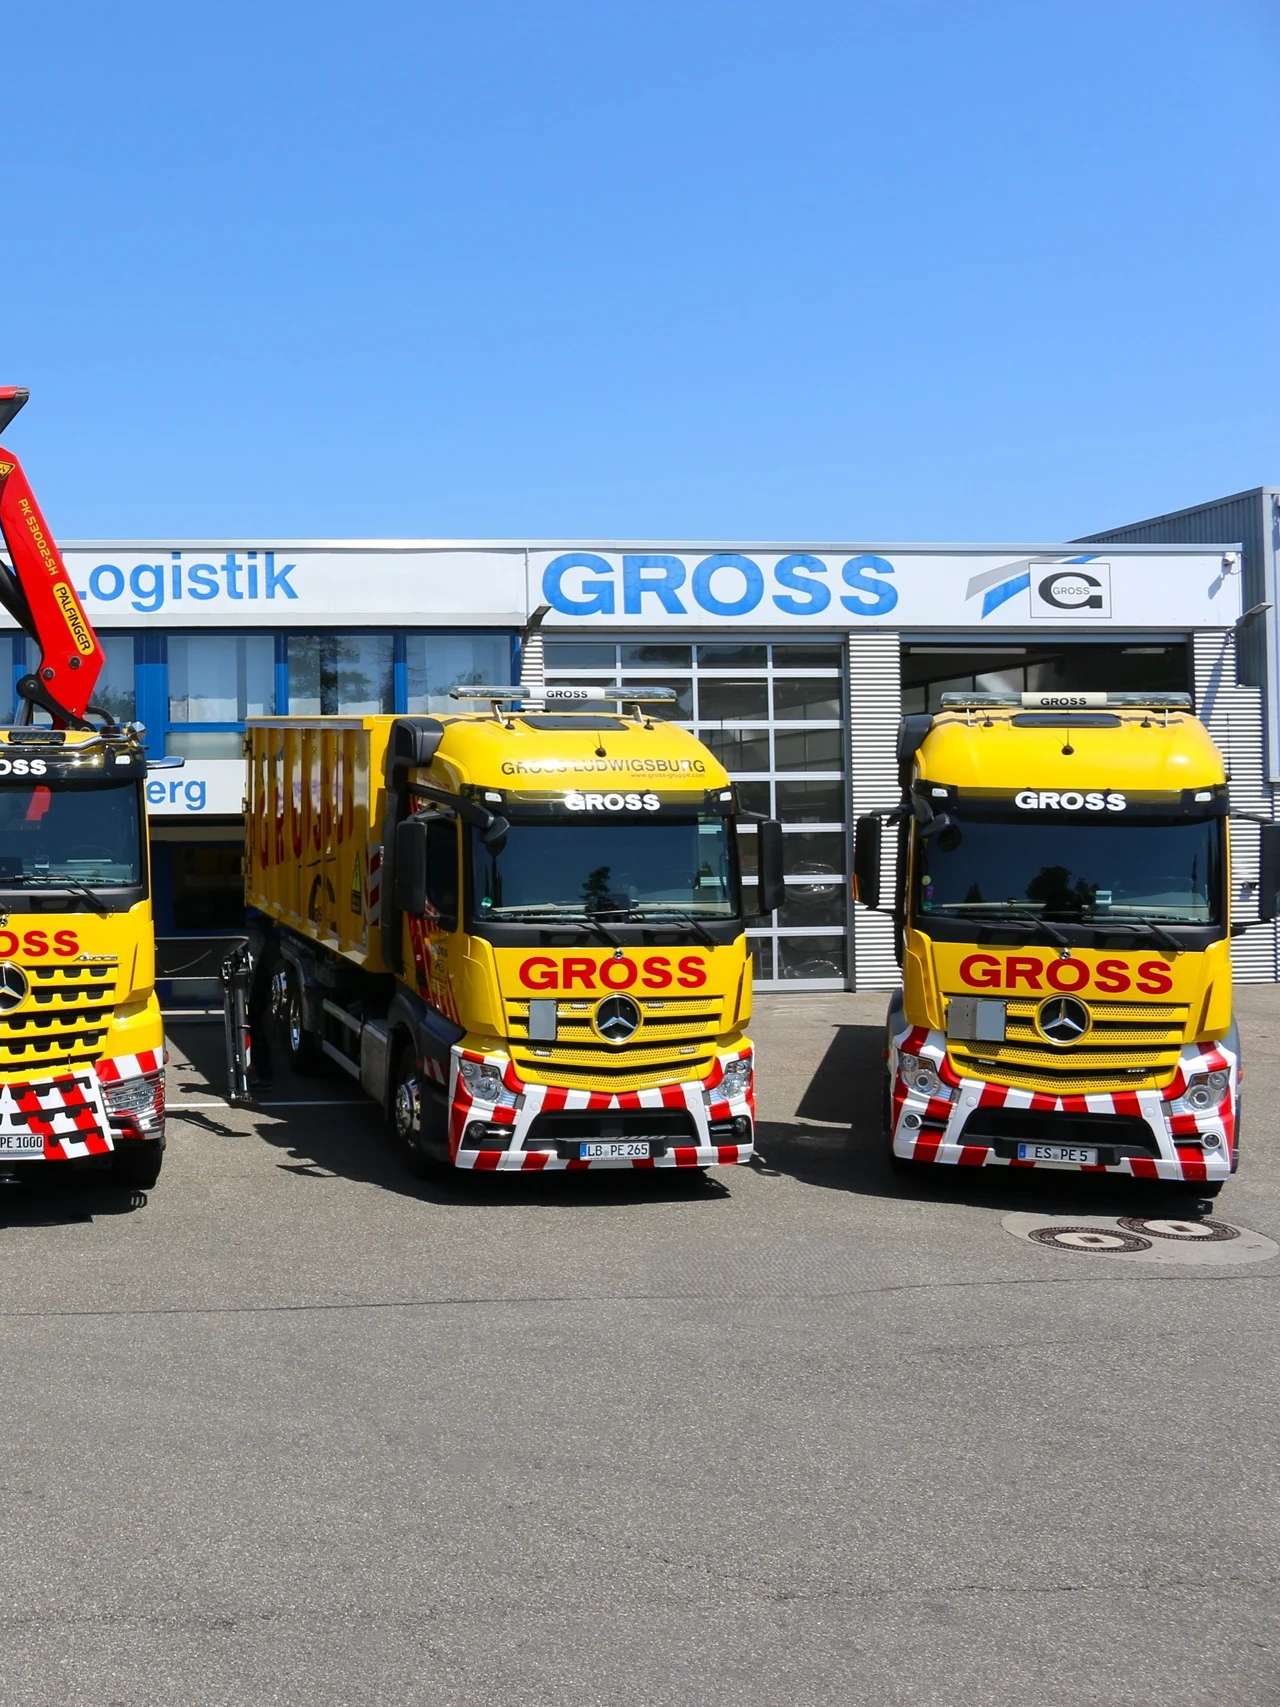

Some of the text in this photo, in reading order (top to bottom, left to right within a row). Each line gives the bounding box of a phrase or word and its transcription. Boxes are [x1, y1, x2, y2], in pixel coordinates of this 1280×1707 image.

[18, 498, 33, 516] PK
[75, 552, 299, 613] ogistik
[542, 553, 899, 616] GROSS
[1052, 586, 1090, 595] GROSS
[56, 586, 91, 651] PALFINGER
[546, 690, 588, 698] GROSS
[1040, 697, 1087, 706] GROSS
[572, 758, 706, 773] LUDWIGSBURG
[565, 792, 661, 811] GROSS
[1015, 791, 1127, 811] GROSS
[519, 956, 707, 990] GROSS
[959, 954, 1173, 995] GROSS
[0, 1136, 14, 1149] PE
[16, 1136, 43, 1149] 1000
[588, 1143, 648, 1157] LB PE 265
[1035, 1146, 1088, 1162] ES PE 5
